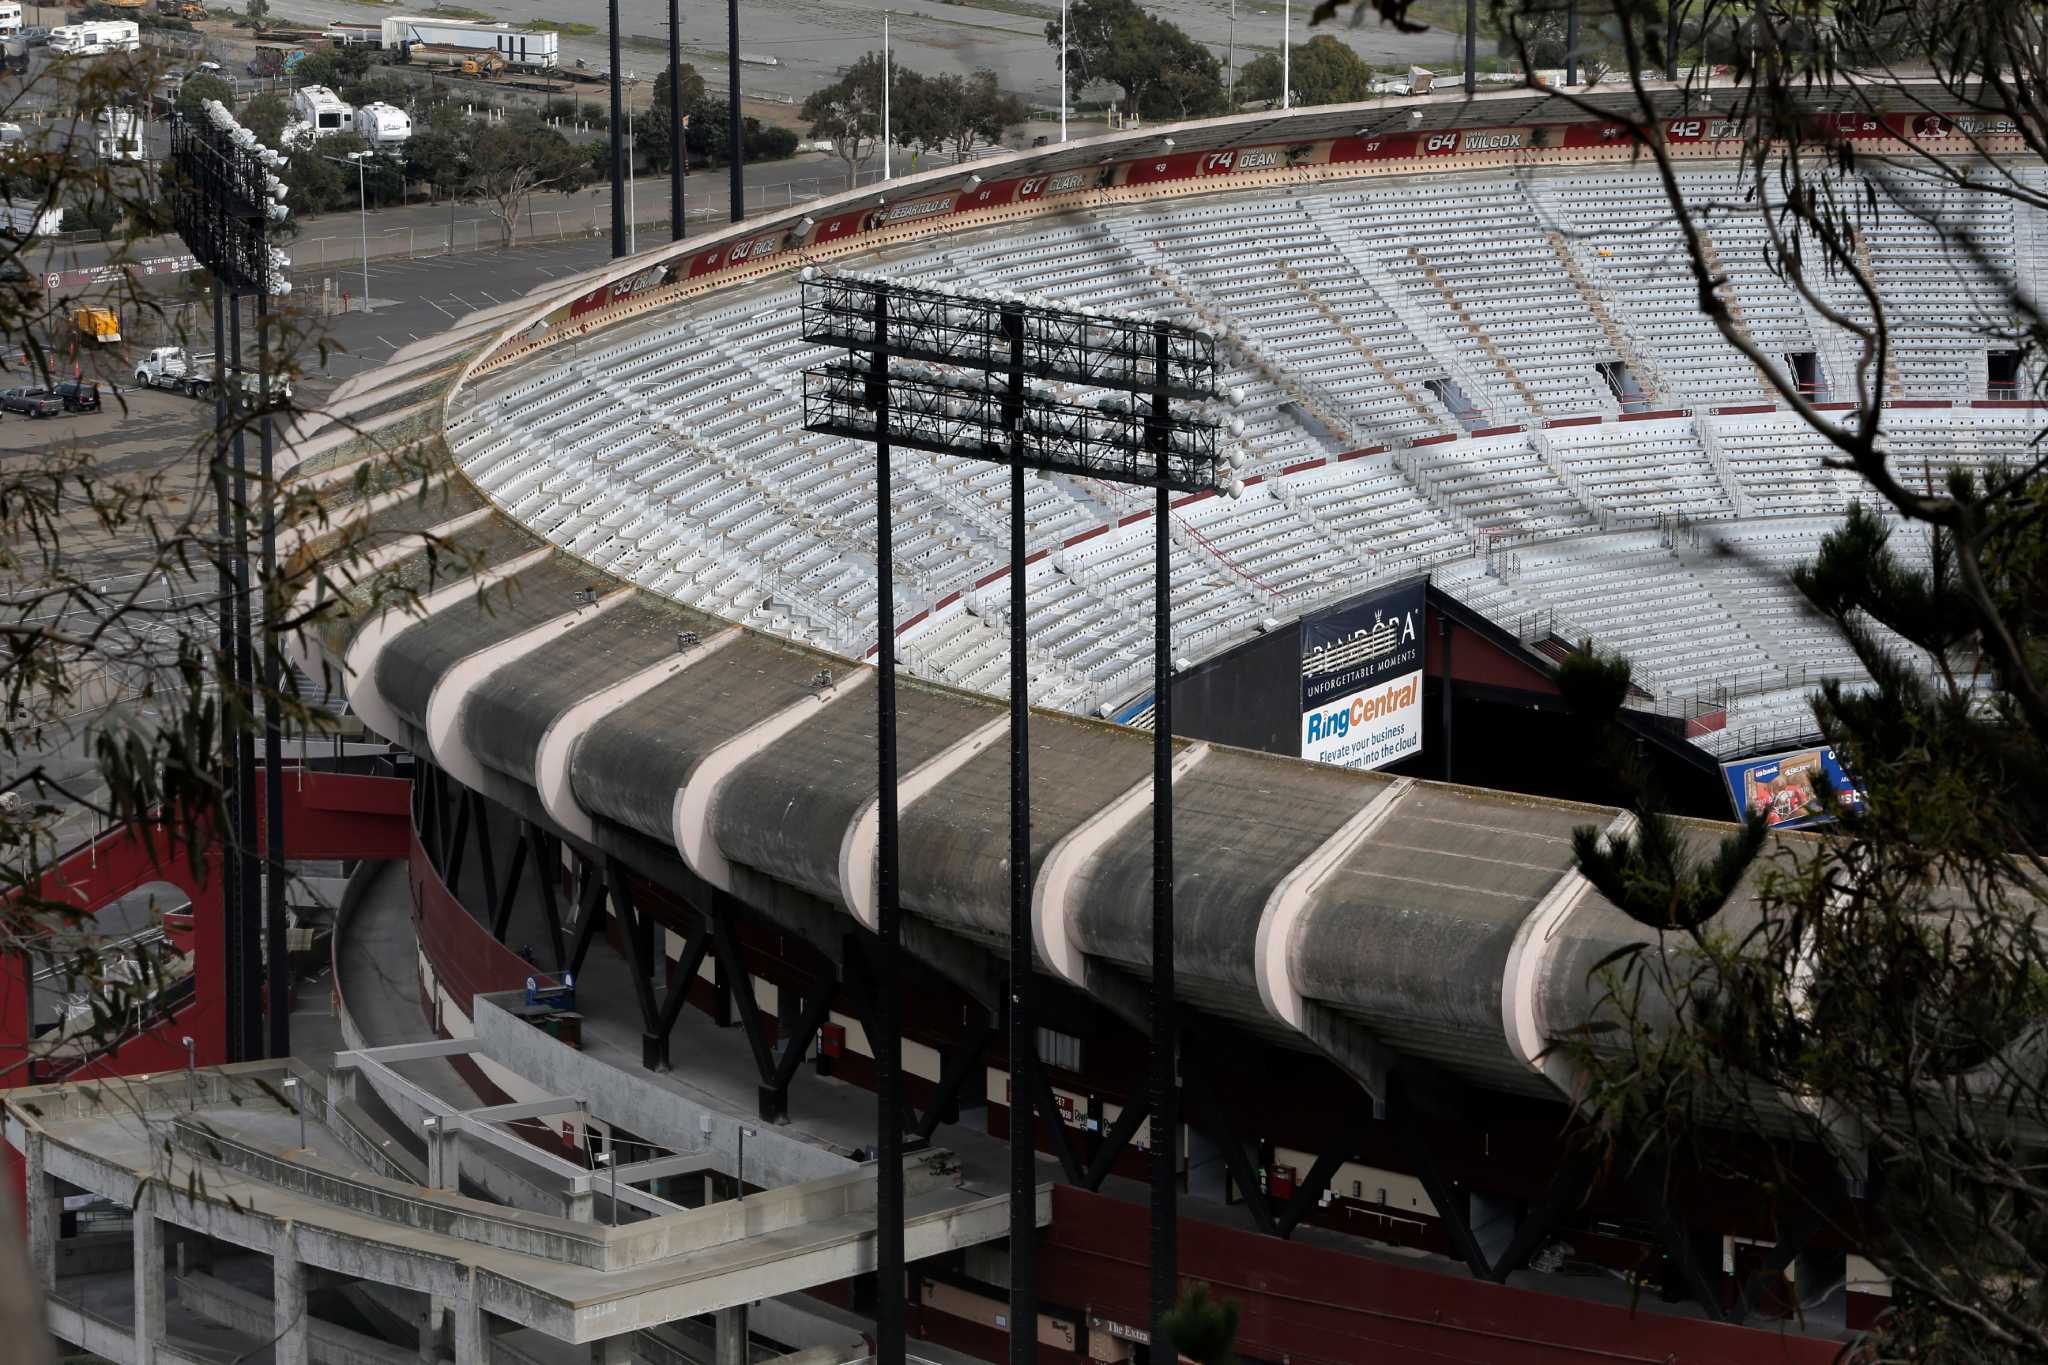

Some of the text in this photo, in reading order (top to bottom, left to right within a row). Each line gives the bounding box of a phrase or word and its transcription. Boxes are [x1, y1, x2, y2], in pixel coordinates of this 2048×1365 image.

[1670, 121, 1700, 138] 42
[1862, 122, 1877, 130] 53
[1366, 142, 1380, 151] 57
[1427, 133, 1521, 151] 64 WILCOX
[1208, 152, 1277, 170] 74 DEAN
[1022, 176, 1048, 195] 87
[1307, 648, 1416, 697] UNFORGETTABLE MOMENTS
[1307, 676, 1418, 744] RingCentral
[1319, 723, 1405, 763] Elevate your business
[1363, 751, 1379, 766] into
[1381, 743, 1394, 759] the
[1395, 732, 1417, 752] cloud
[1106, 1320, 1149, 1342] The Extra
